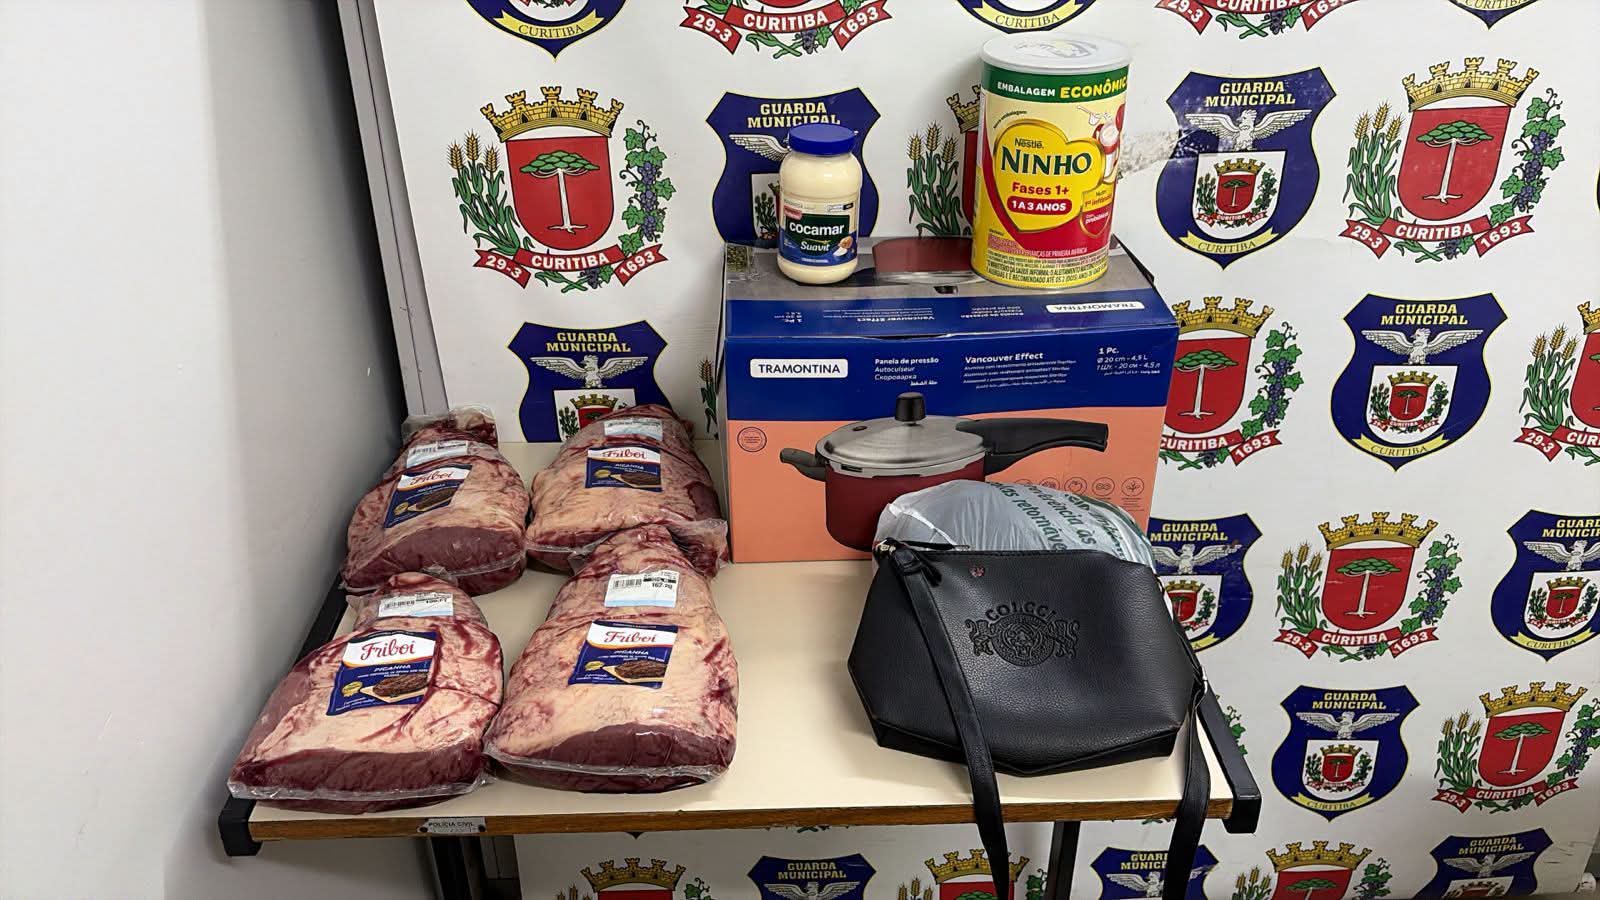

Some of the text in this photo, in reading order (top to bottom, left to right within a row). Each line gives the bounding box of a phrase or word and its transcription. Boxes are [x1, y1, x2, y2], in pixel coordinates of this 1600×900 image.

[1168, 0, 1204, 23] 29-3
[743, 10, 829, 31] CURITIBA
[838, 6, 879, 39] 1693
[995, 13, 1060, 28] CURITIBA
[518, 24, 584, 38] CURITIBA
[694, 14, 733, 43] 29-3
[997, 75, 1128, 99] EMBALAGEM ECONÔMIC
[1220, 81, 1285, 94] GUARDA
[1204, 93, 1296, 107] MUNICIPAL
[760, 102, 827, 115] GUARDA
[747, 114, 841, 128] MUNICIPAL
[1001, 145, 1092, 176] NINHO
[1012, 181, 1070, 196] Fases 1+
[1012, 200, 1067, 212] 1 A 3 ANOS
[789, 222, 845, 236] cocamar
[1395, 223, 1473, 240] CURITIBA
[1480, 221, 1522, 249] 1693
[1351, 226, 1383, 249] 29-3
[1197, 240, 1257, 253] CURITIBA
[486, 255, 523, 279] 29-3
[531, 255, 610, 270] CURITIBA
[619, 251, 656, 278] 1693
[1055, 303, 1136, 311] TRAMONTINA
[1395, 303, 1458, 314] GUARDA
[1380, 315, 1469, 325] MUNICIPAL
[556, 332, 618, 342] GUARDA
[546, 342, 632, 352] MUNICIPAL
[910, 357, 939, 365] pressão
[965, 352, 1044, 364] Vancouver Effect
[758, 364, 841, 373] TRAMONTINA
[1160, 436, 1228, 450] CURITIBA
[1235, 435, 1272, 458] 1693
[1524, 432, 1555, 453] 29-3
[603, 448, 648, 460] Friboi
[1371, 445, 1428, 457] CURITIBA
[1162, 523, 1218, 533] GUARDA
[1150, 532, 1229, 541] MUNICIPAL
[604, 631, 657, 643] Friboi
[1283, 633, 1312, 652] 29-3
[1321, 632, 1388, 645] CURITIBA
[1393, 631, 1429, 654] 1693
[1526, 639, 1577, 649] CURITIBA
[360, 639, 416, 661] Friboi
[1324, 692, 1377, 701] GUARDA
[1312, 701, 1387, 709] MUNICIPAL
[1475, 786, 1534, 800] CURITIBA
[1538, 782, 1571, 801] 1693
[1442, 792, 1467, 808] 29-3
[1469, 836, 1517, 847] GUARDA
[1458, 843, 1525, 855] MUNICIPAL
[787, 862, 837, 871] GUARDA
[777, 870, 847, 880] MUNICIPAL
